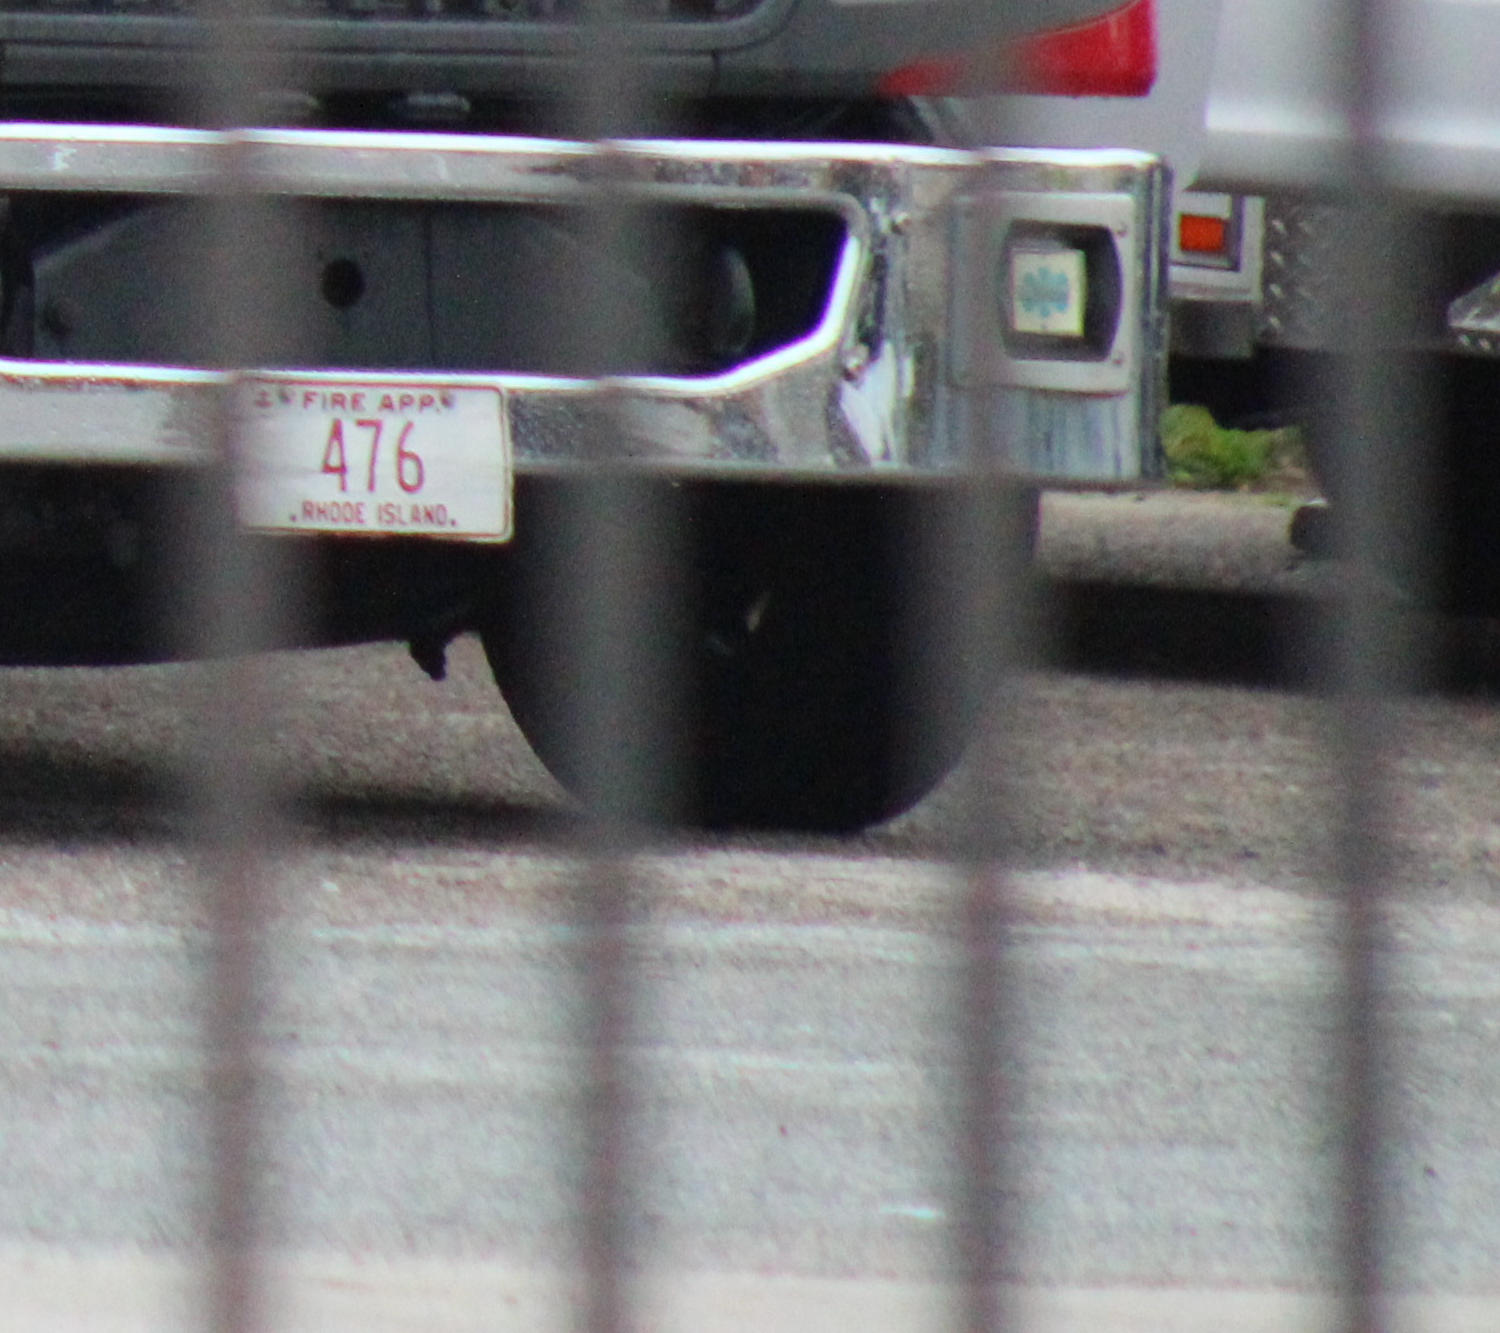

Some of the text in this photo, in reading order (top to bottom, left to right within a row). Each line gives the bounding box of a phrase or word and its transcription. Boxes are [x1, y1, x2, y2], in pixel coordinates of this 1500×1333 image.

[302, 390, 366, 411] FIRE
[320, 418, 425, 494] 476
[302, 500, 449, 526] RHODE ISLAND
